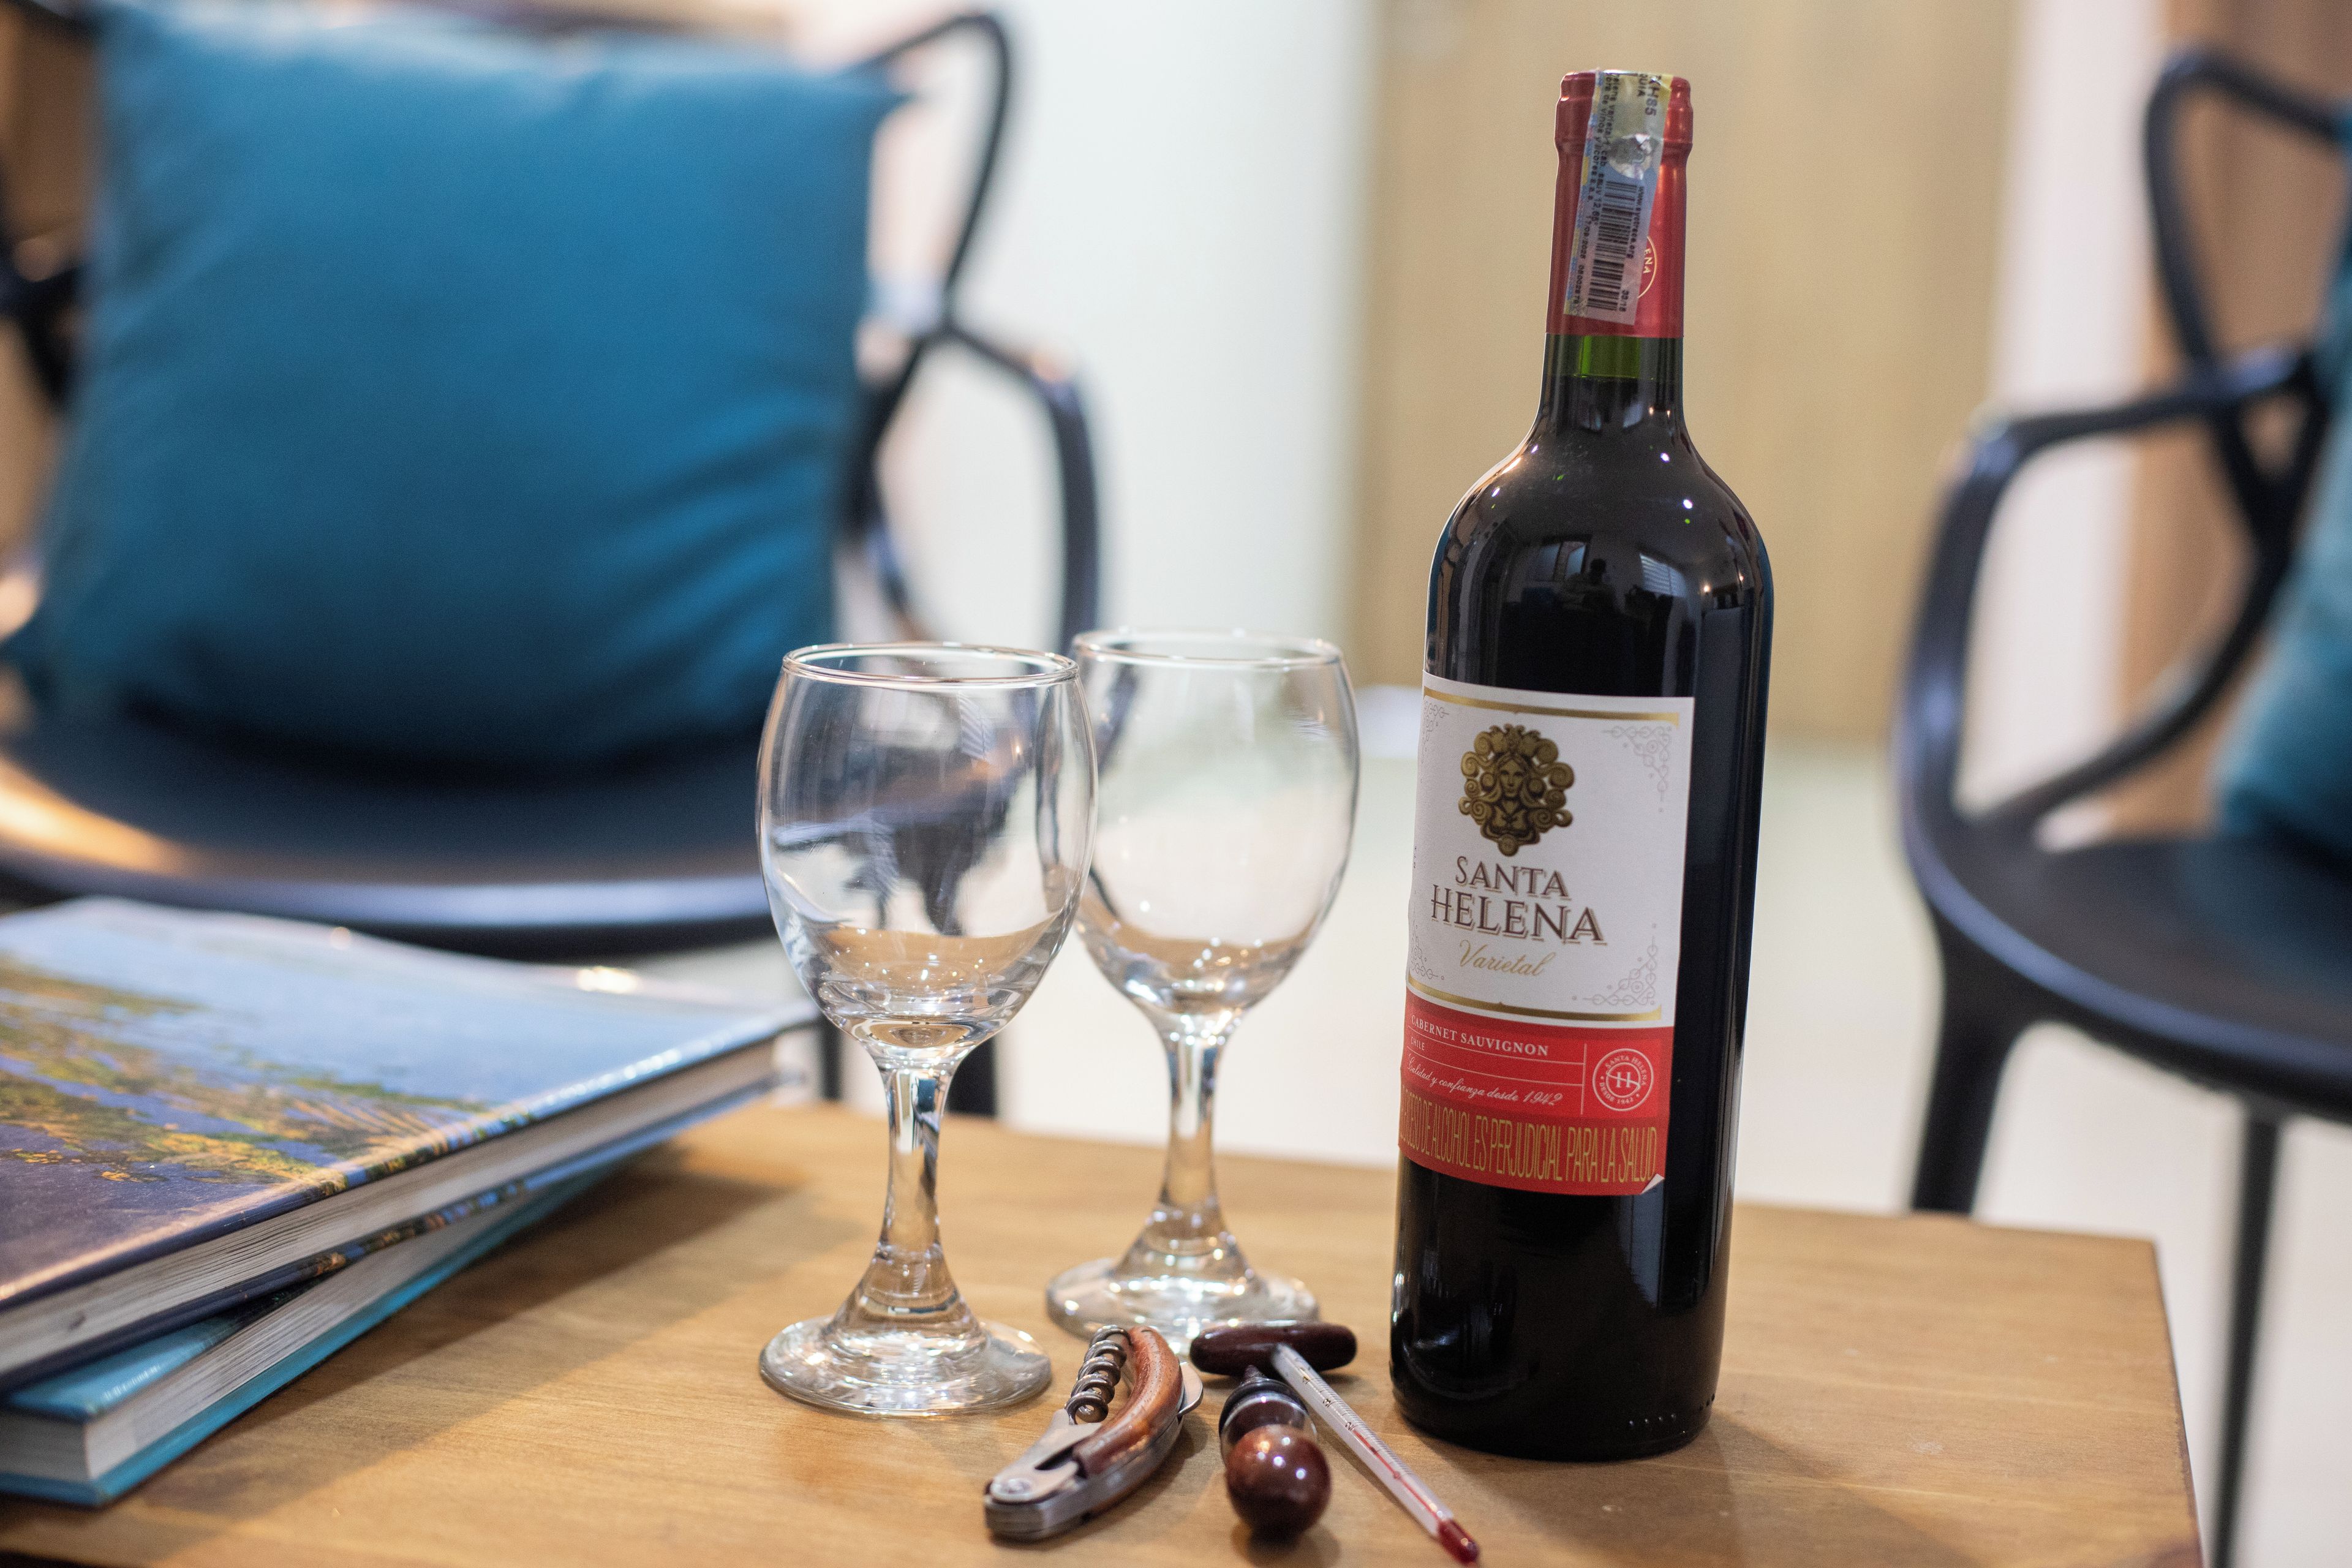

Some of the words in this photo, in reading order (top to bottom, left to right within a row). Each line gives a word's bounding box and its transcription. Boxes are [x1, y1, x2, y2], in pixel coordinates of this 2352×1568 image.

[1455, 856, 1571, 900] SANTA
[1431, 884, 1607, 945] HELENA
[1459, 940, 1556, 976] Varietal
[1410, 1036, 1425, 1052] CHILE
[1411, 1014, 1457, 1042] CABERNET
[1460, 1033, 1548, 1057] SAUVIGNON
[1407, 1054, 1431, 1082] Calidad
[1430, 1076, 1438, 1087] y
[1439, 1077, 1485, 1098] confianza
[1485, 1087, 1518, 1102] desde
[1523, 1090, 1563, 1107] 1942
[1605, 1055, 1630, 1069] SANTA
[1431, 1104, 1471, 1168] ALCOHOL
[1473, 1115, 1488, 1171] ES
[1489, 1118, 1562, 1182] PERJUDICIAL
[1566, 1126, 1598, 1183] PARA
[1600, 1127, 1616, 1183] LA
[1618, 1126, 1657, 1183] SALUD
